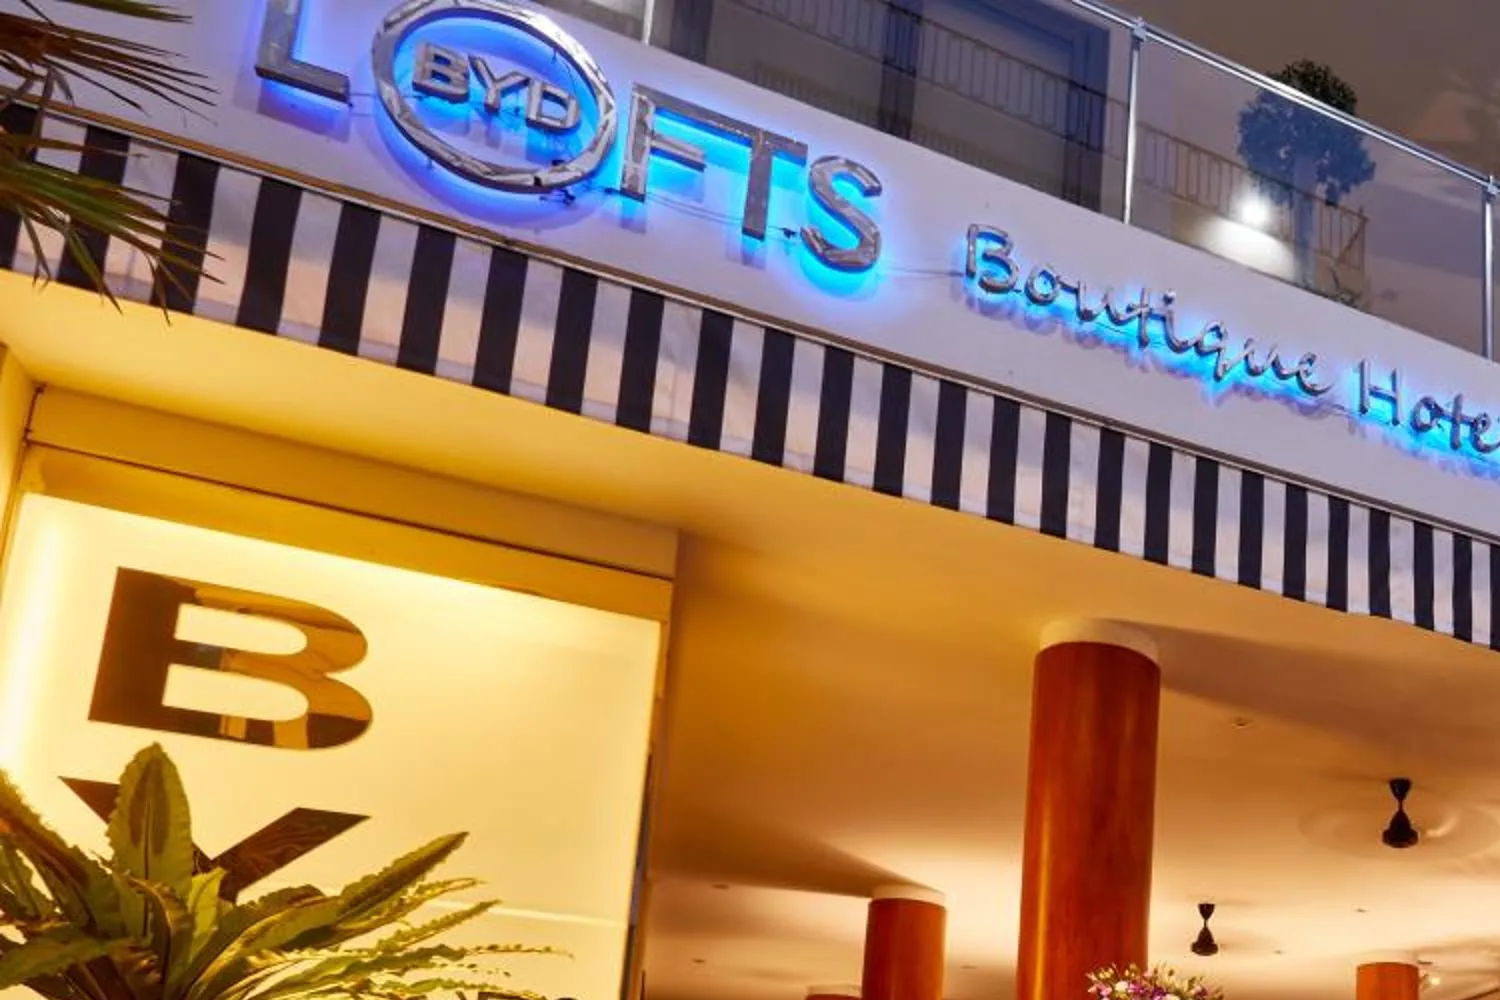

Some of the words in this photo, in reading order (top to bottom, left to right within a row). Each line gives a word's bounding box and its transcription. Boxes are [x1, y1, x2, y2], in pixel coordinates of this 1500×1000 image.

[255, 0, 883, 272] LOFTS
[411, 40, 583, 136] BYD
[964, 223, 1334, 396] Boutique
